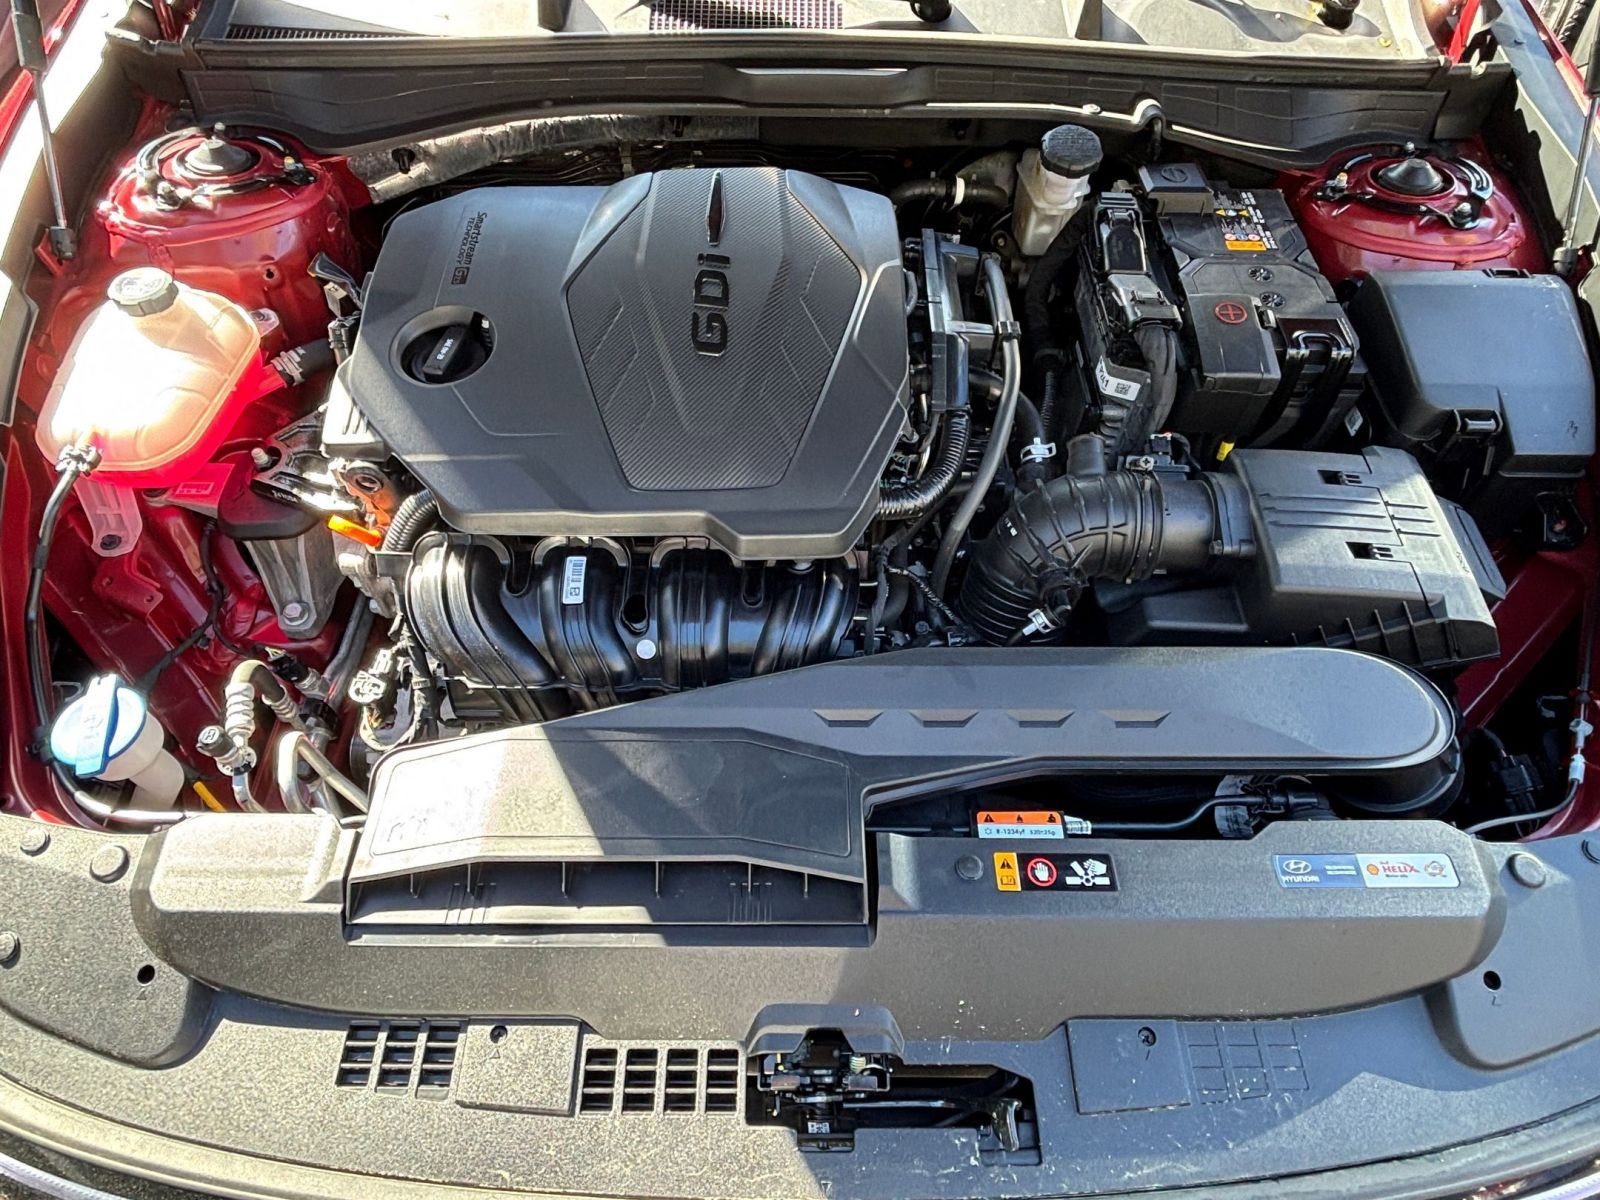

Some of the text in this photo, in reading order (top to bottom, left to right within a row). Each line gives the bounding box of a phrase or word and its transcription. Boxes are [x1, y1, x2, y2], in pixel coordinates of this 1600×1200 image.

[456, 217, 476, 265] TECHNOLOGY
[464, 211, 488, 265] Smartstream
[691, 253, 730, 356] GDi
[1281, 875, 1320, 883] HYUNDAI
[1382, 864, 1420, 873] HELIX
